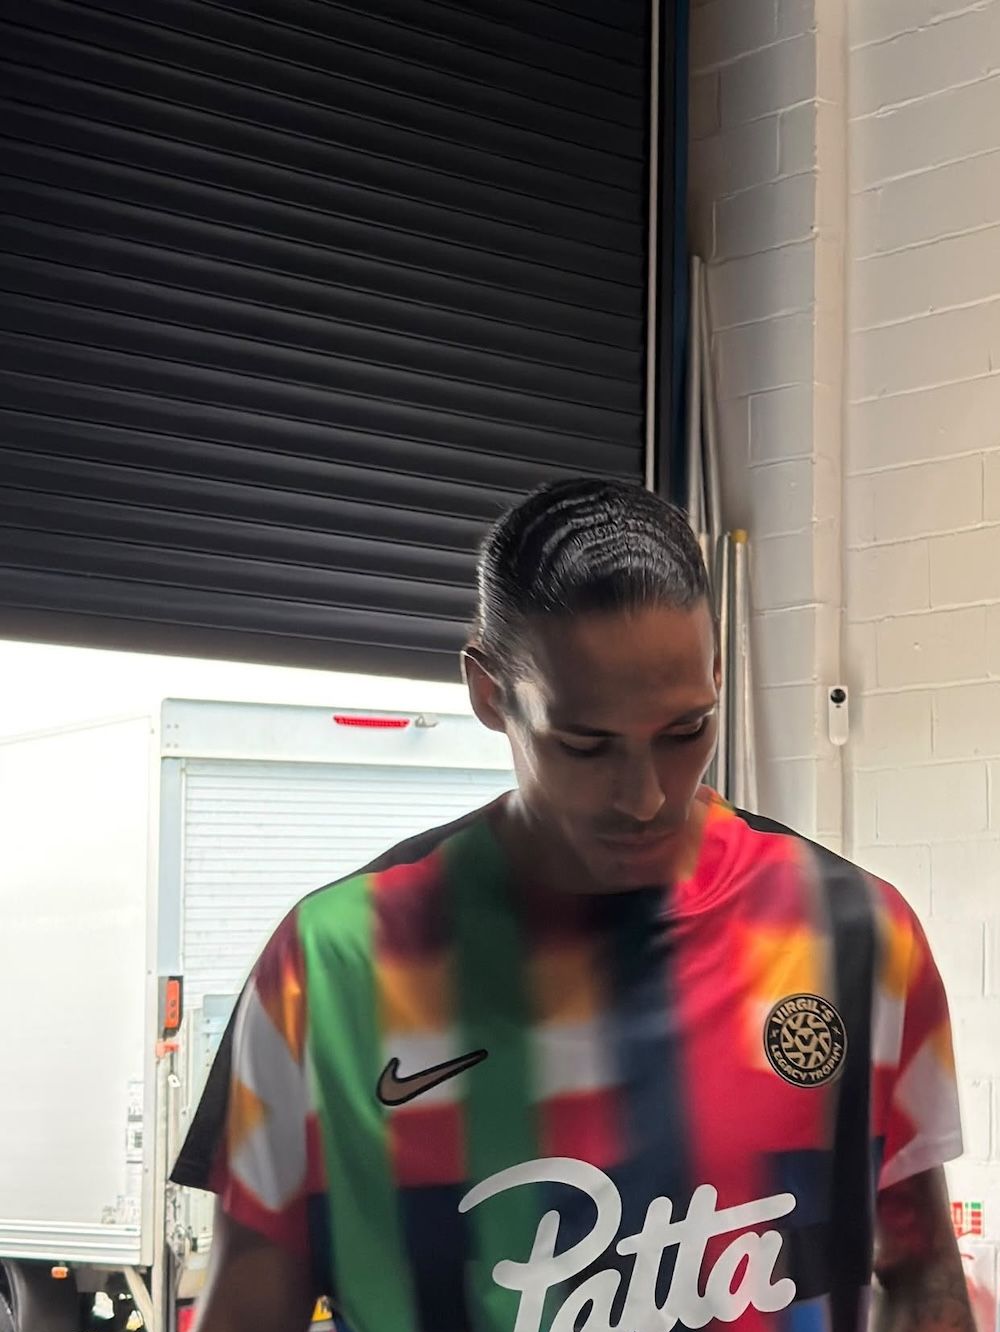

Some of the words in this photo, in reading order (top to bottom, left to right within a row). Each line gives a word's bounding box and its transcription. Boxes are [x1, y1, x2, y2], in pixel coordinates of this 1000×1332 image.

[772, 998, 835, 1024] VIRGIL'S
[771, 1044, 807, 1081] LEGACY
[809, 1042, 843, 1081] TROPHY
